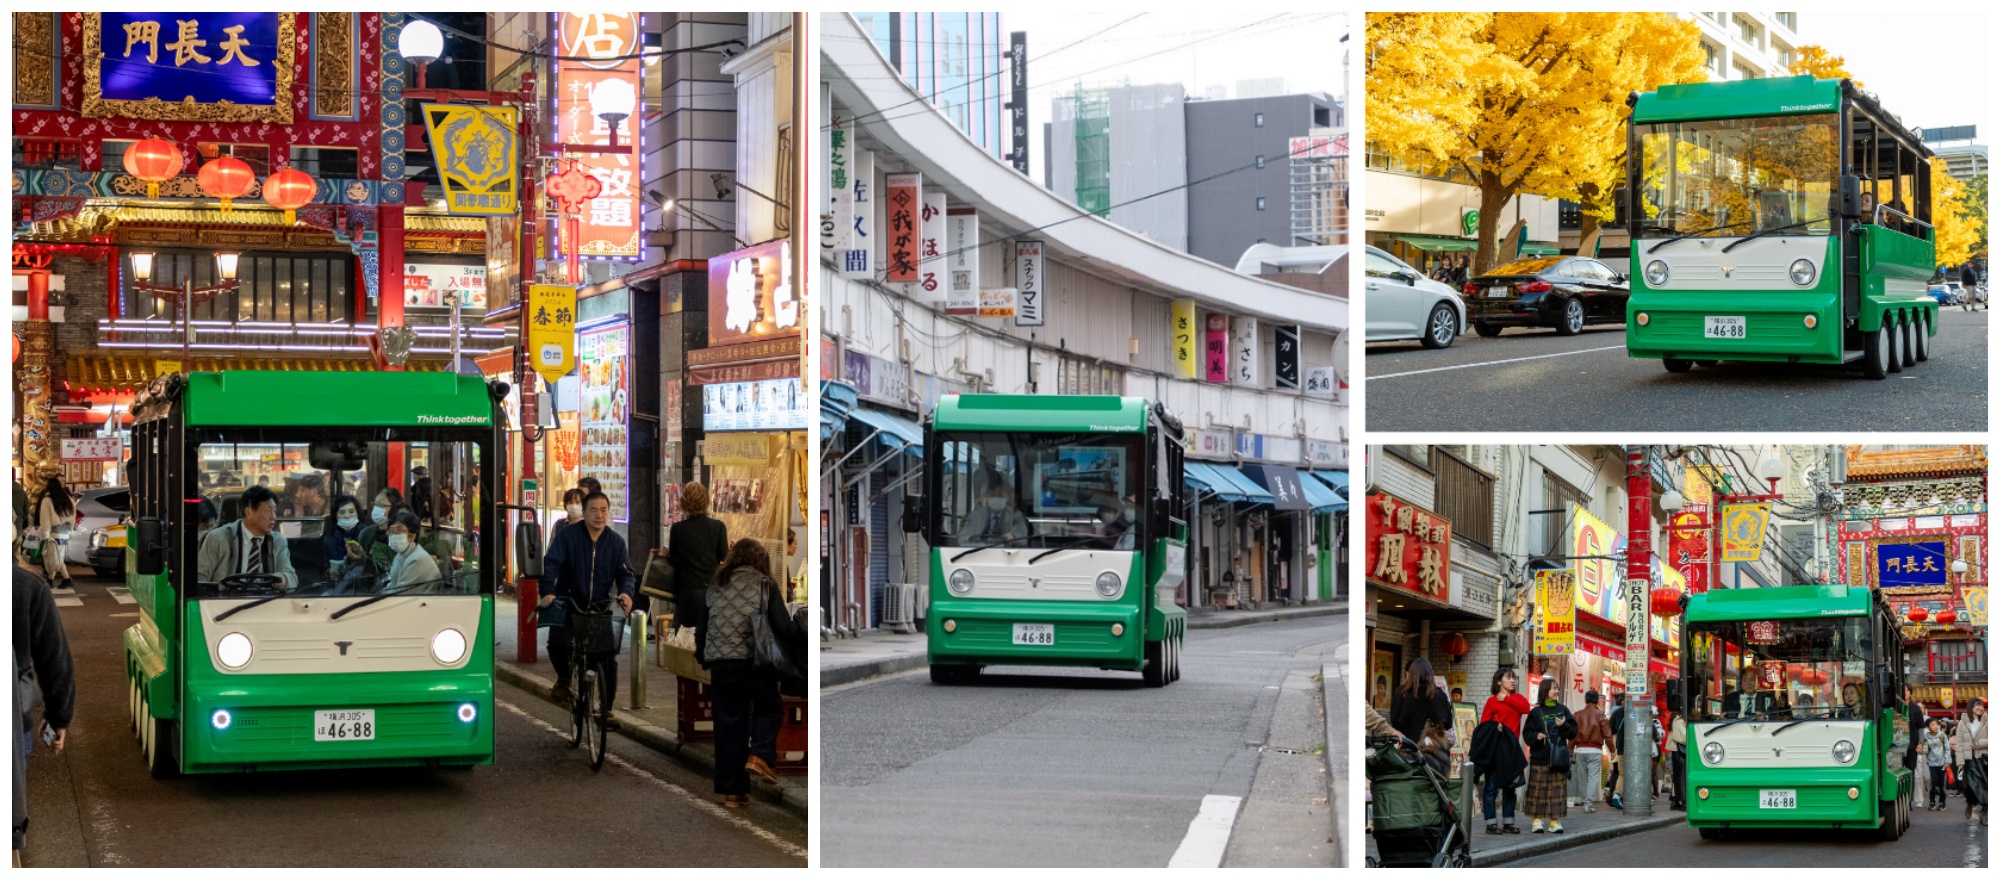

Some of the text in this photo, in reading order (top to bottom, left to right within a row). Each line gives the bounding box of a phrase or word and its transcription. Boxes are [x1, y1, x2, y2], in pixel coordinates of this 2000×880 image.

[891, 209, 916, 276] 我が家
[921, 203, 940, 292] かほる
[1024, 258, 1034, 290] スナック
[533, 305, 572, 327] 春節
[1021, 290, 1036, 320] マミ
[1176, 316, 1189, 361] さつき
[1713, 325, 1744, 337] 46-88
[1208, 340, 1223, 375] 明美
[1241, 346, 1251, 382] さち
[1581, 531, 1600, 597] 占
[1630, 586, 1643, 611] BAR
[1021, 632, 1052, 644] 46-88
[1573, 673, 1584, 694] 元
[328, 722, 372, 739] 46-88
[1768, 797, 1794, 808] 46-88
